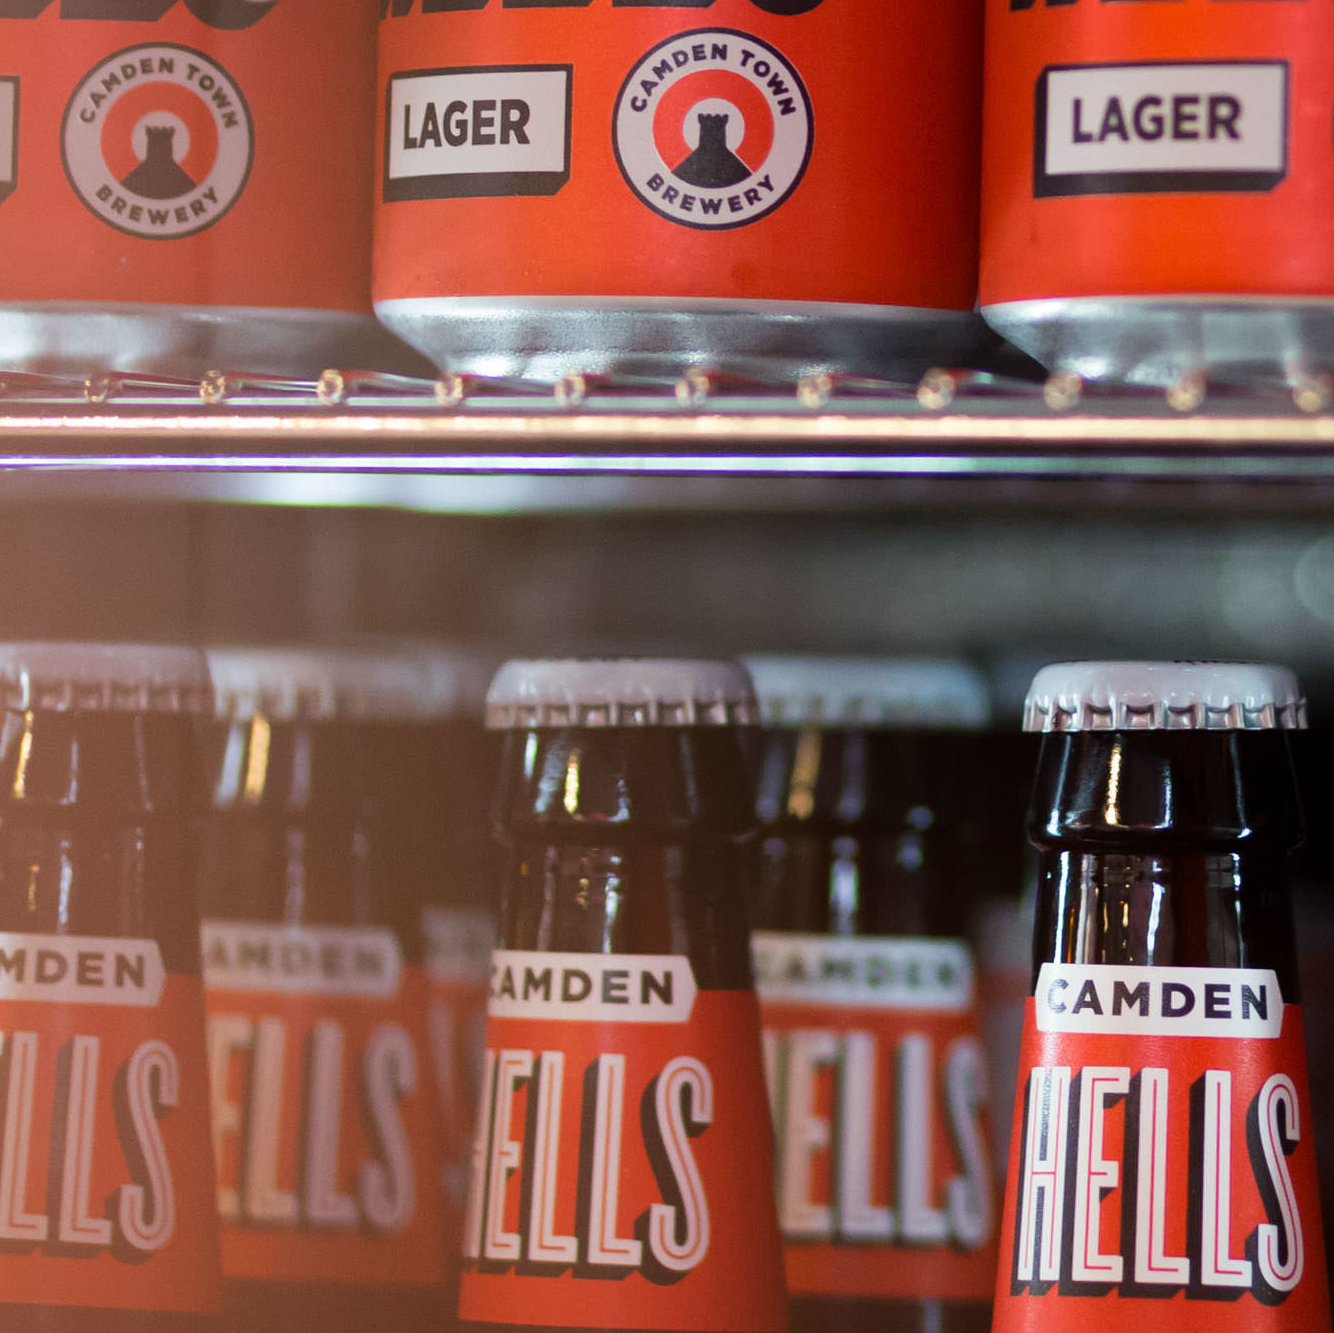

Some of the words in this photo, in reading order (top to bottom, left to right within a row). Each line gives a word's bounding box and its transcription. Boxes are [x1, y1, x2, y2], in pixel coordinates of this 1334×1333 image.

[79, 57, 175, 125] CAMDEN
[184, 63, 240, 129] TOWN
[629, 43, 728, 114] CAMDEN
[739, 50, 797, 117] TOWN
[402, 97, 531, 150] LAGER
[1071, 93, 1243, 144] LAGER
[95, 184, 220, 225] BREWERY
[646, 172, 777, 215] BREWERY
[1047, 977, 1268, 1021] CAMDEN
[1011, 1066, 1304, 1306] HELLS
